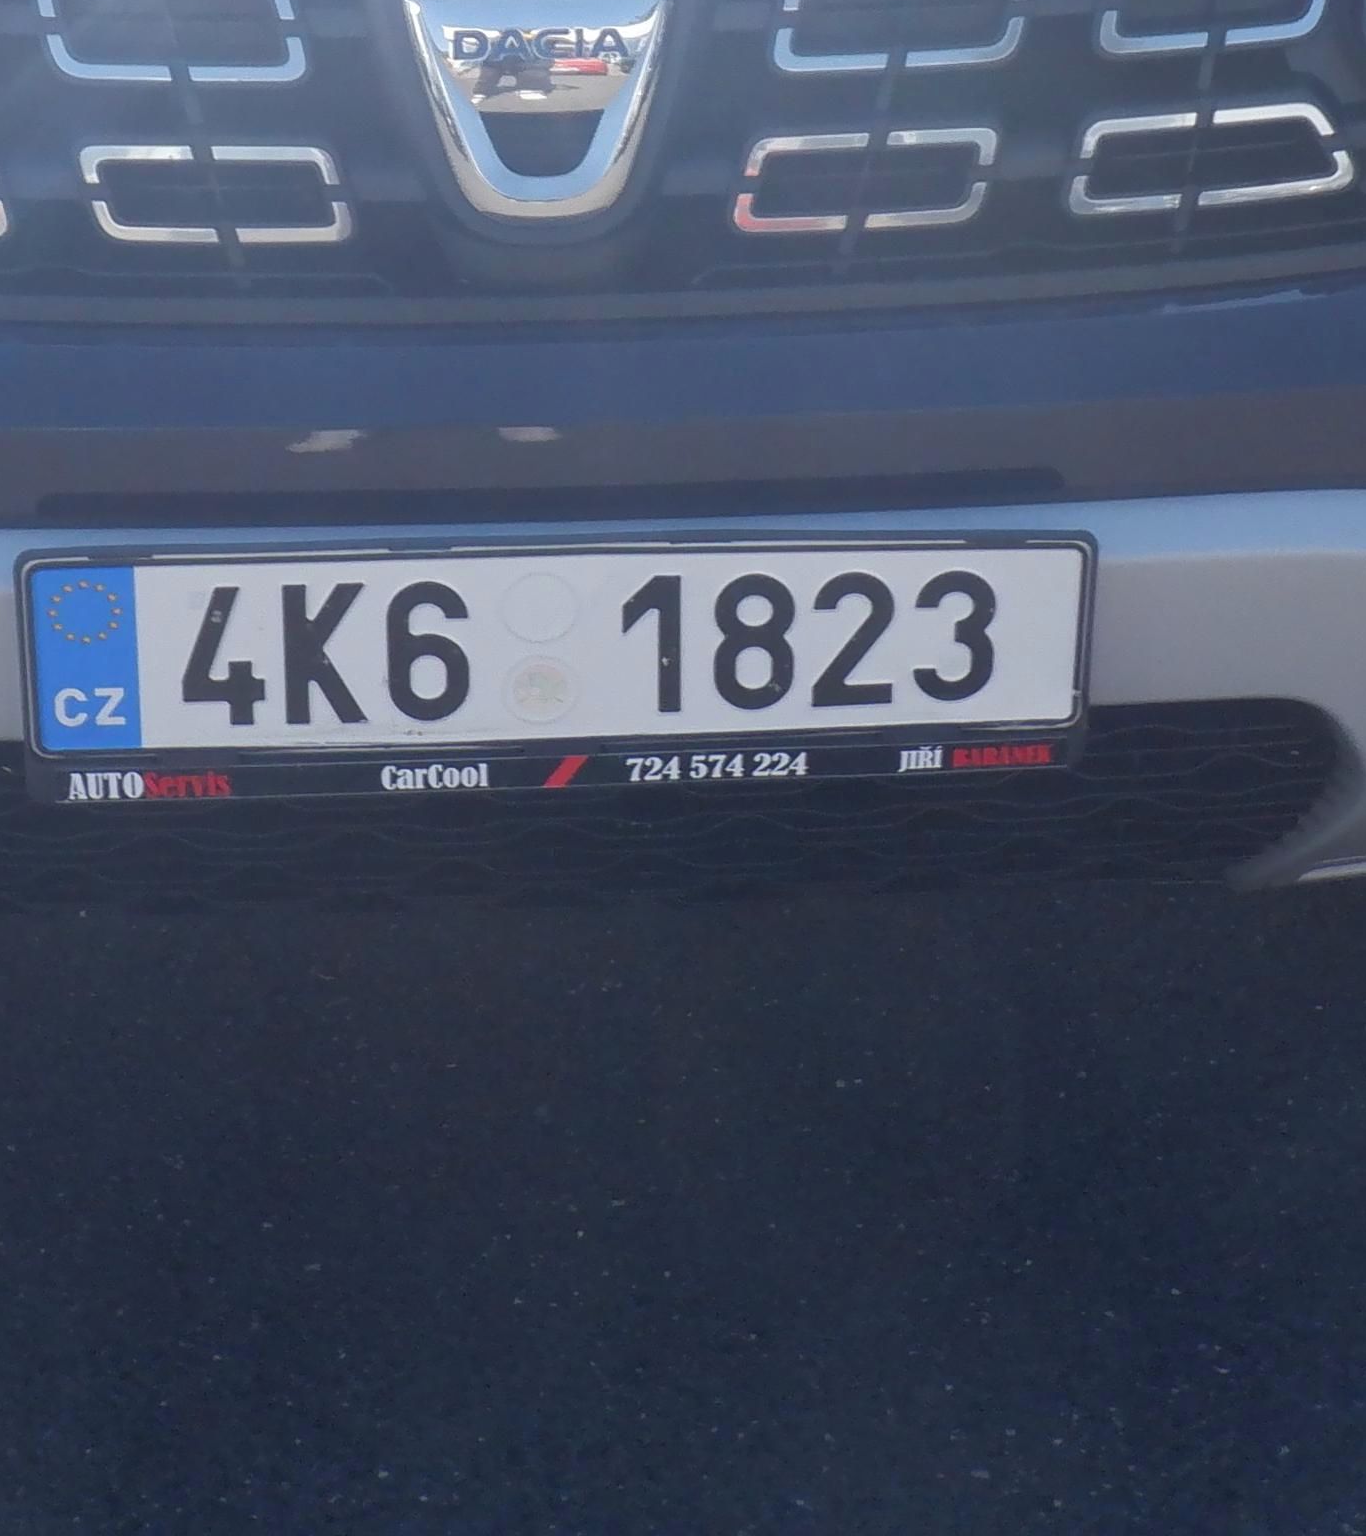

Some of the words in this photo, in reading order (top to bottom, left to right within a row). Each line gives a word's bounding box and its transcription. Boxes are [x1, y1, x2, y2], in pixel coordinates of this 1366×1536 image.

[452, 28, 629, 61] DACIA
[182, 580, 470, 726] 4K6
[621, 570, 996, 713] 1823
[53, 686, 127, 728] CZ
[381, 763, 489, 791] CarCool
[625, 756, 681, 783] 724
[690, 753, 744, 779] 574
[752, 751, 809, 777] 224
[898, 746, 943, 772] JIŘÍ
